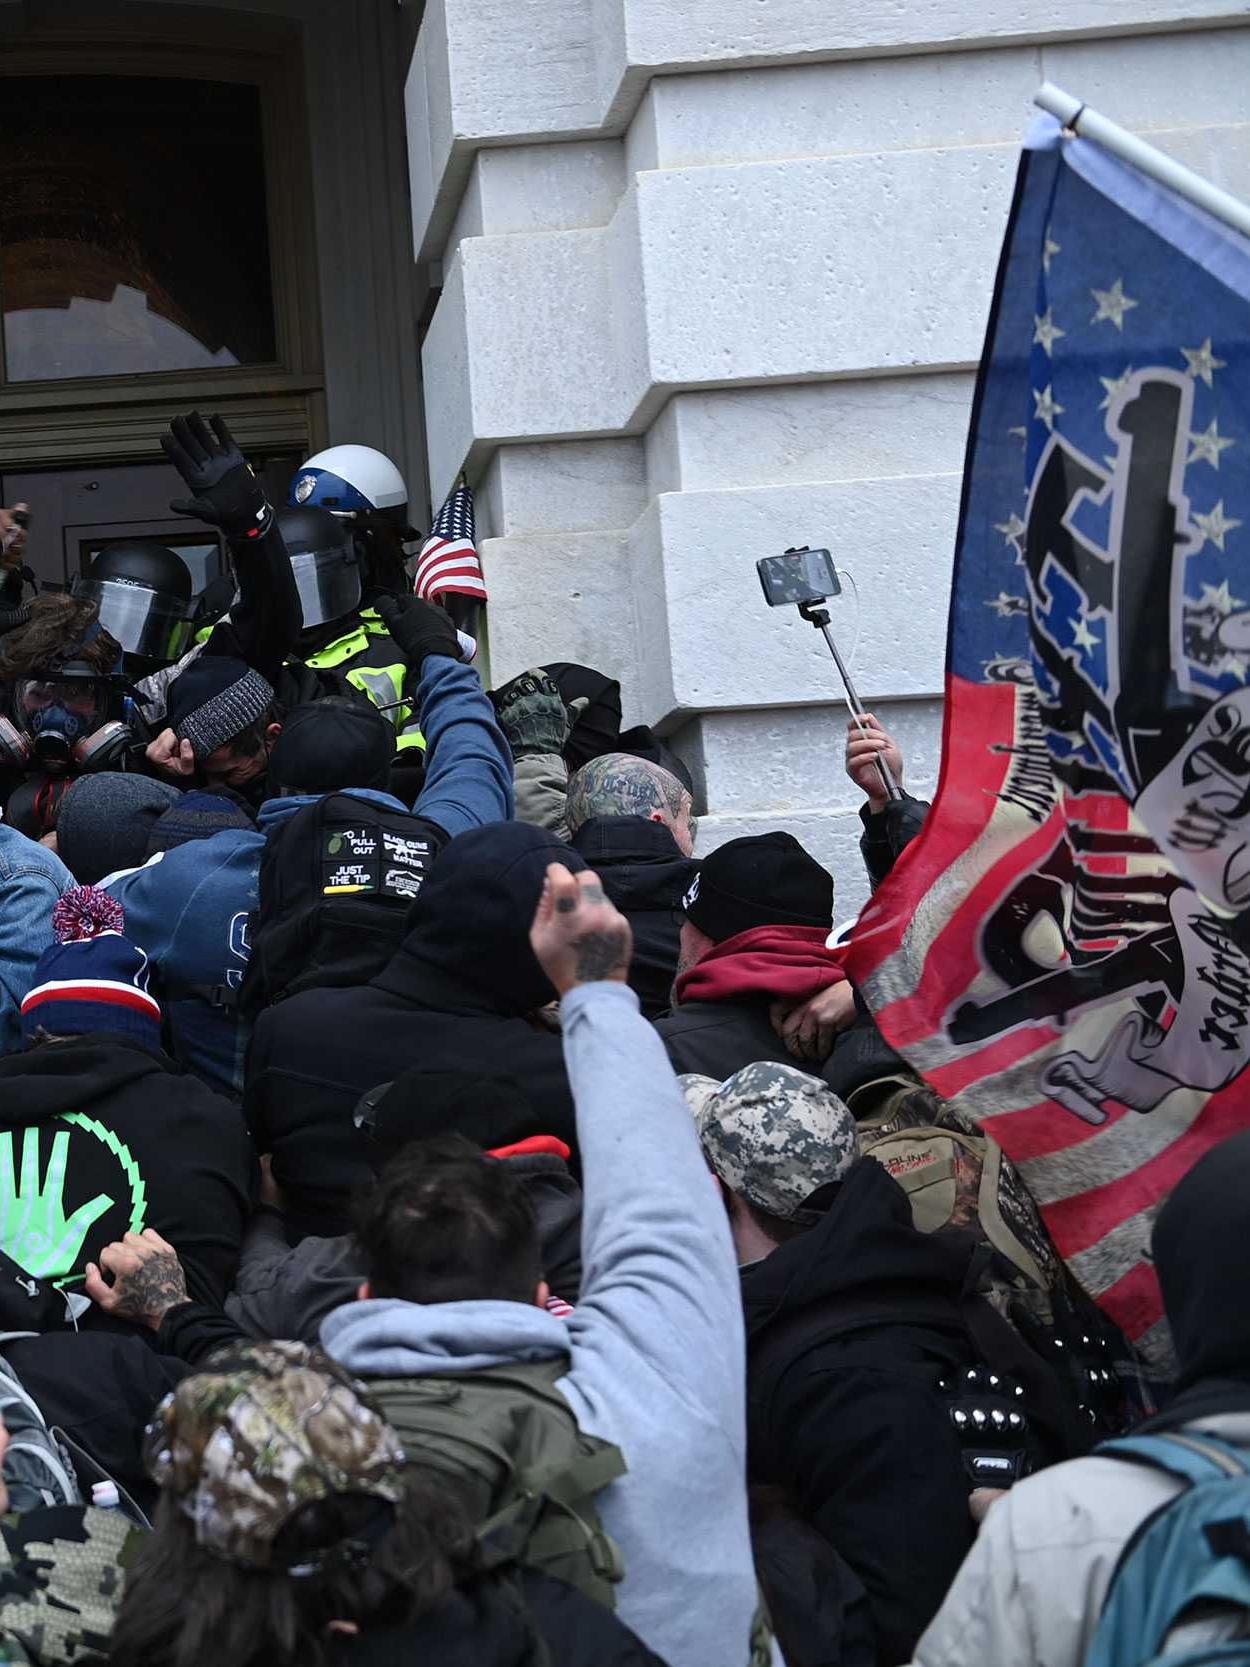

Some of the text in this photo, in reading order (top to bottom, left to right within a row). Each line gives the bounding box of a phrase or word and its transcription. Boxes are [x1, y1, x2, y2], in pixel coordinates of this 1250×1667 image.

[361, 829, 367, 838] I
[350, 838, 377, 847] PULL
[352, 846, 375, 855] OUT
[335, 865, 364, 876] JUST
[329, 875, 351, 886] THE
[352, 873, 371, 884] TIP
